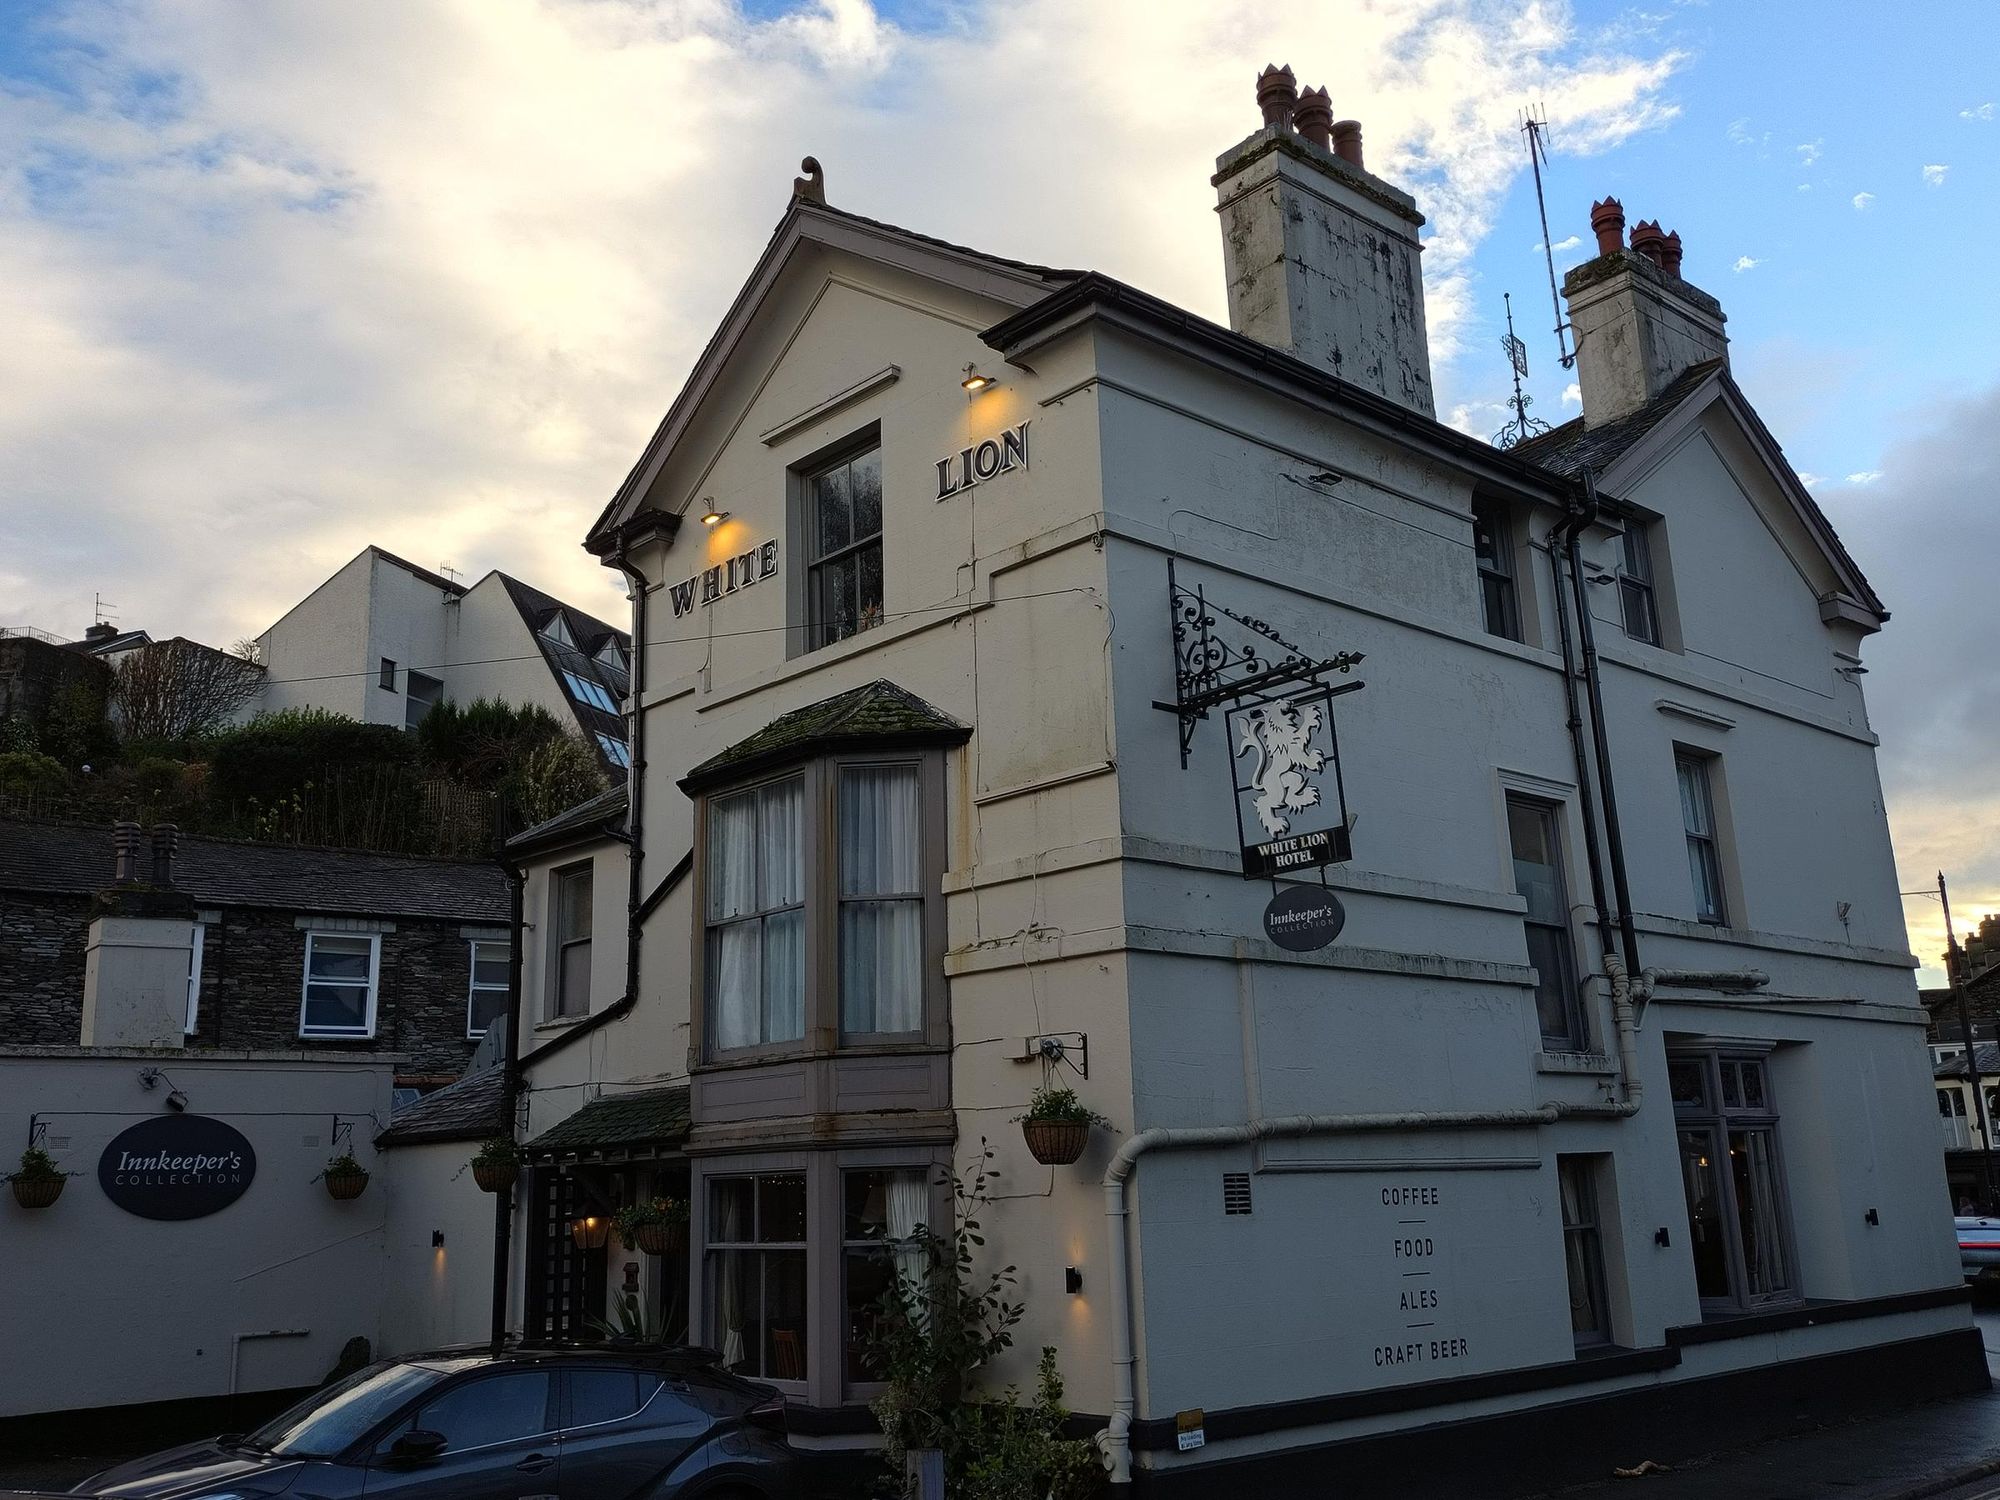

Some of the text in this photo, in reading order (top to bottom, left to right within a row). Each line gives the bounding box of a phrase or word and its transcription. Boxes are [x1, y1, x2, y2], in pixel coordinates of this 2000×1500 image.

[933, 419, 1030, 502] LION
[667, 538, 777, 618] WHITE
[1258, 833, 1329, 856] WHITE LION
[1276, 850, 1314, 867] HOTEL
[1270, 905, 1332, 926] Innkeeper's
[1270, 919, 1334, 935] COLLECTION
[117, 1150, 241, 1175] Innkeeper's
[115, 1173, 240, 1185] COLLECTION
[1381, 1187, 1439, 1206] COFFEE
[1394, 1238, 1433, 1258] FOOD
[1400, 1289, 1438, 1311] ALES
[1374, 1338, 1468, 1367] CRAFT BEER
